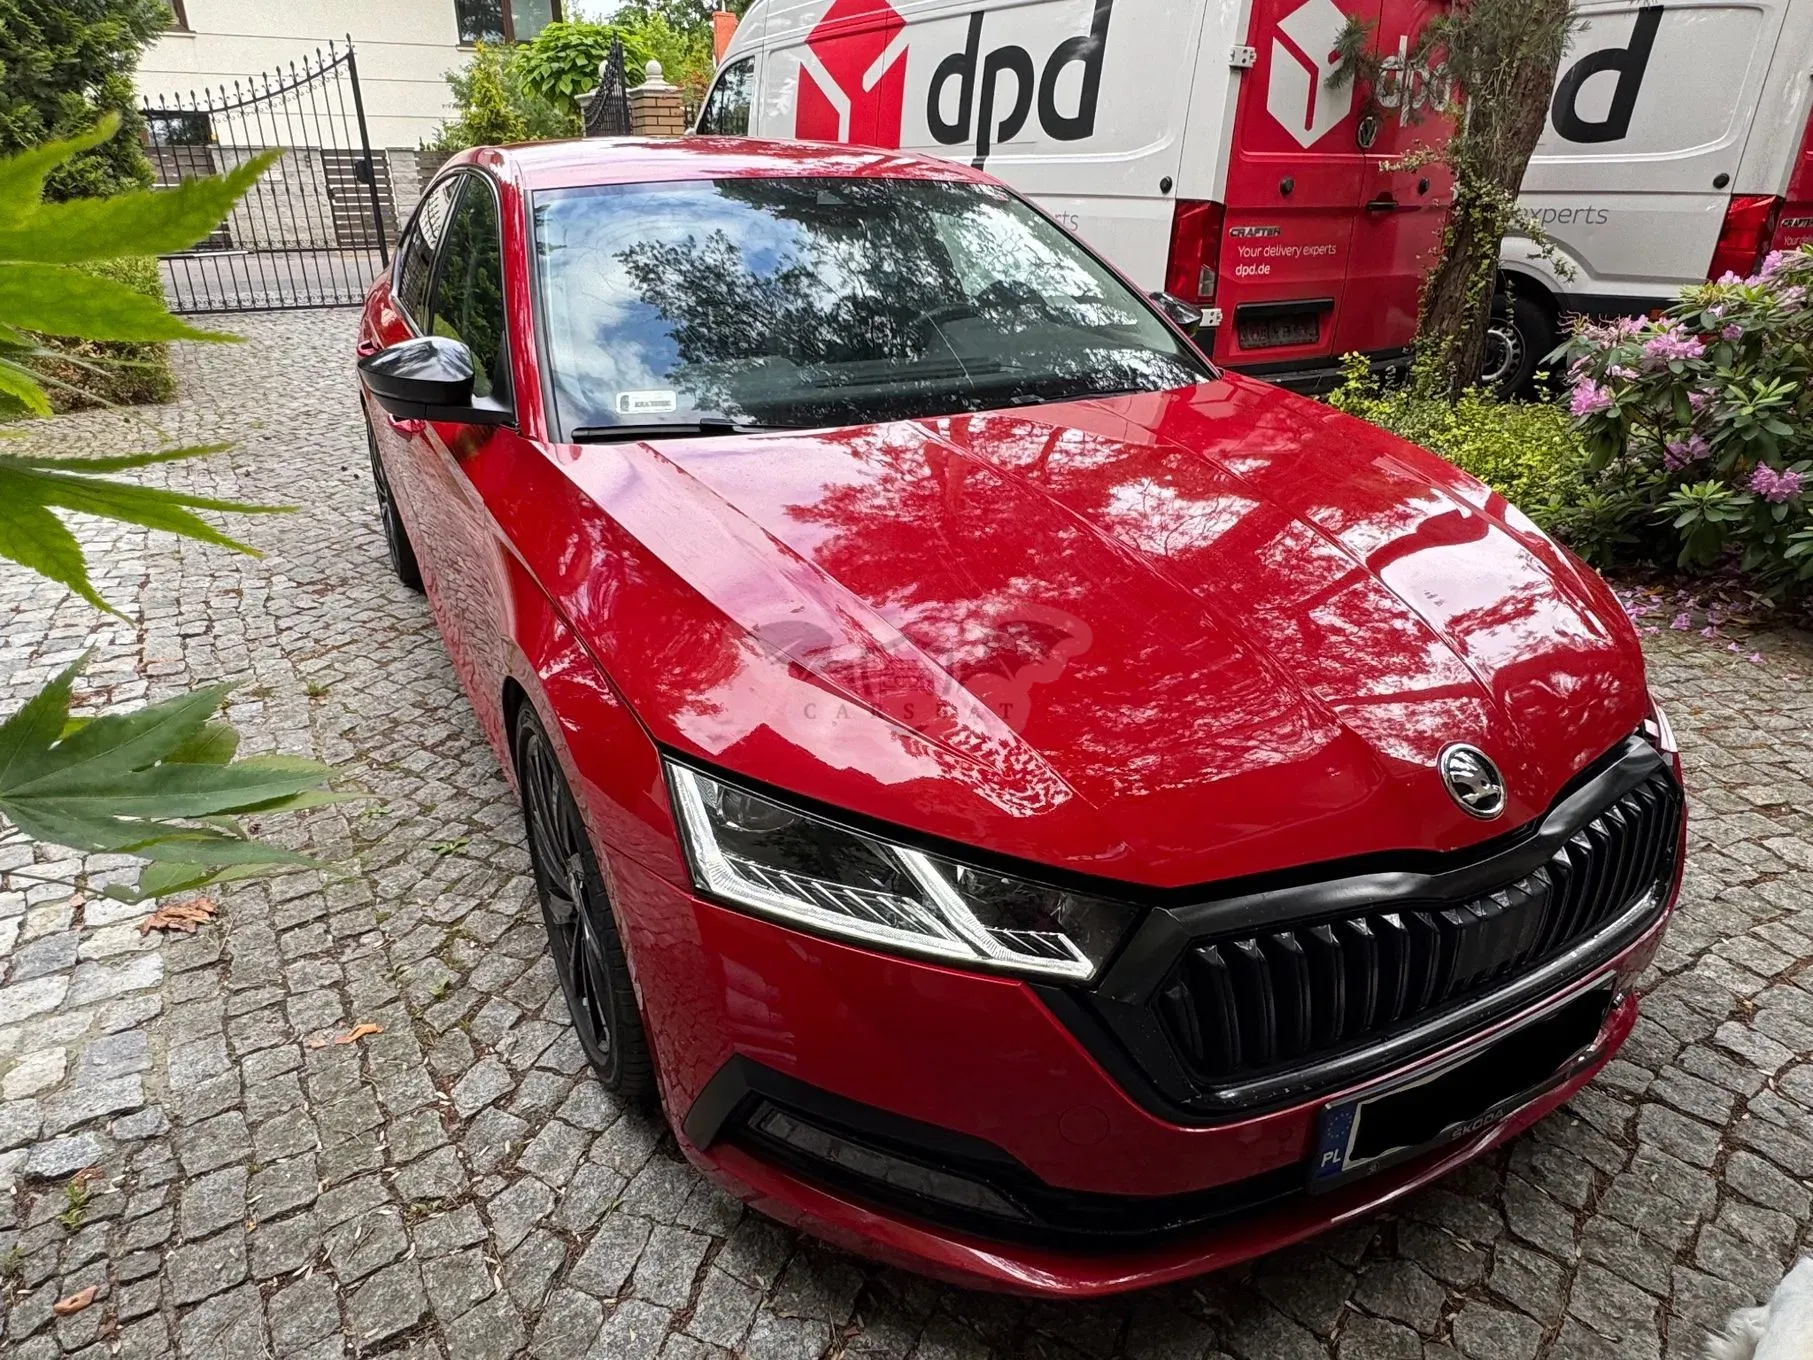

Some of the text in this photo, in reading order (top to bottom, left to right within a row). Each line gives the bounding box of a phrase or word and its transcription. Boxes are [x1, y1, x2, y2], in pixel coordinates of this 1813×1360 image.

[927, 0, 1113, 170] dpd
[1237, 243, 1337, 259] Your delivery experts
[1235, 263, 1271, 277] dpd.de
[1320, 1148, 1342, 1168] PL
